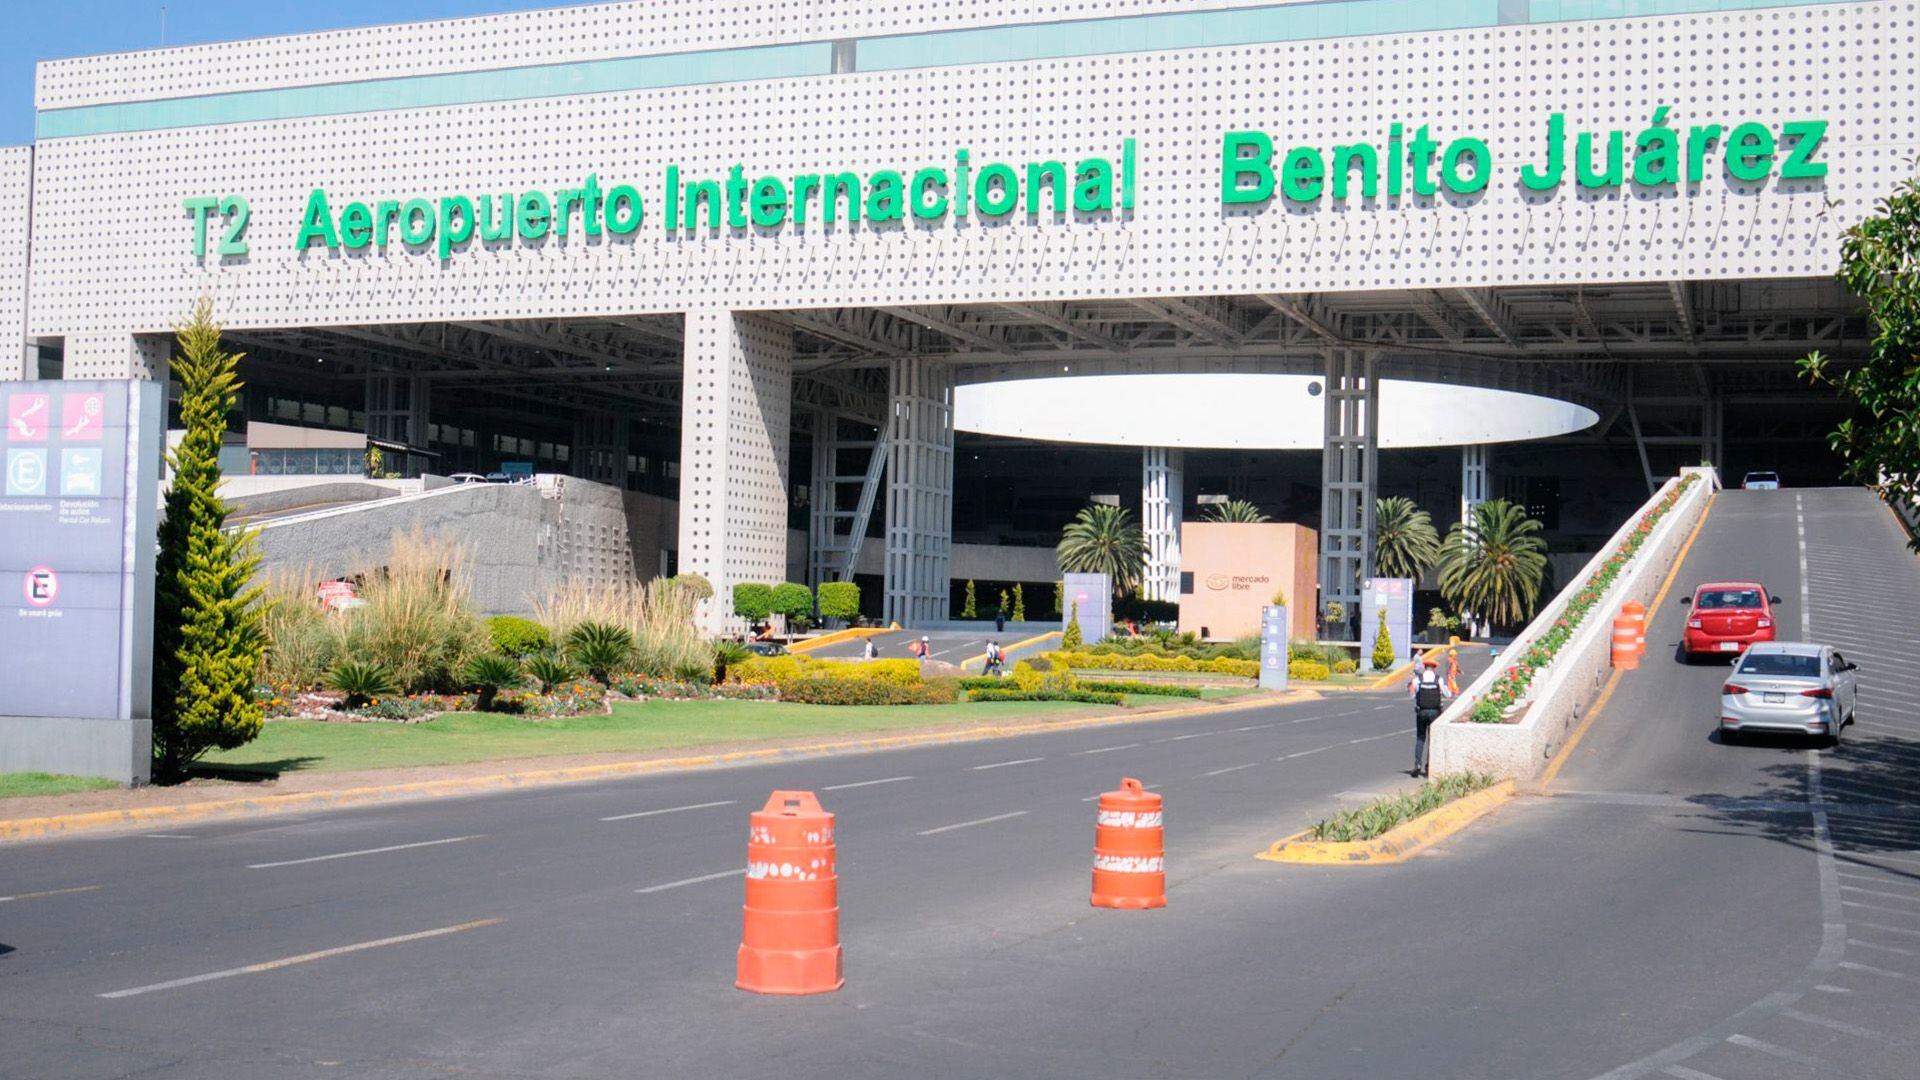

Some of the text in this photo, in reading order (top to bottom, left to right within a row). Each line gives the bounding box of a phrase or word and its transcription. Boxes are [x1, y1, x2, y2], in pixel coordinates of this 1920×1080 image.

[183, 105, 1828, 261] T2 Aeropuerto Internacional Benito Juárez
[19, 458, 34, 484] E
[0, 502, 52, 511] stacionamiento
[32, 574, 50, 598] E
[1232, 575, 1269, 583] mercado
